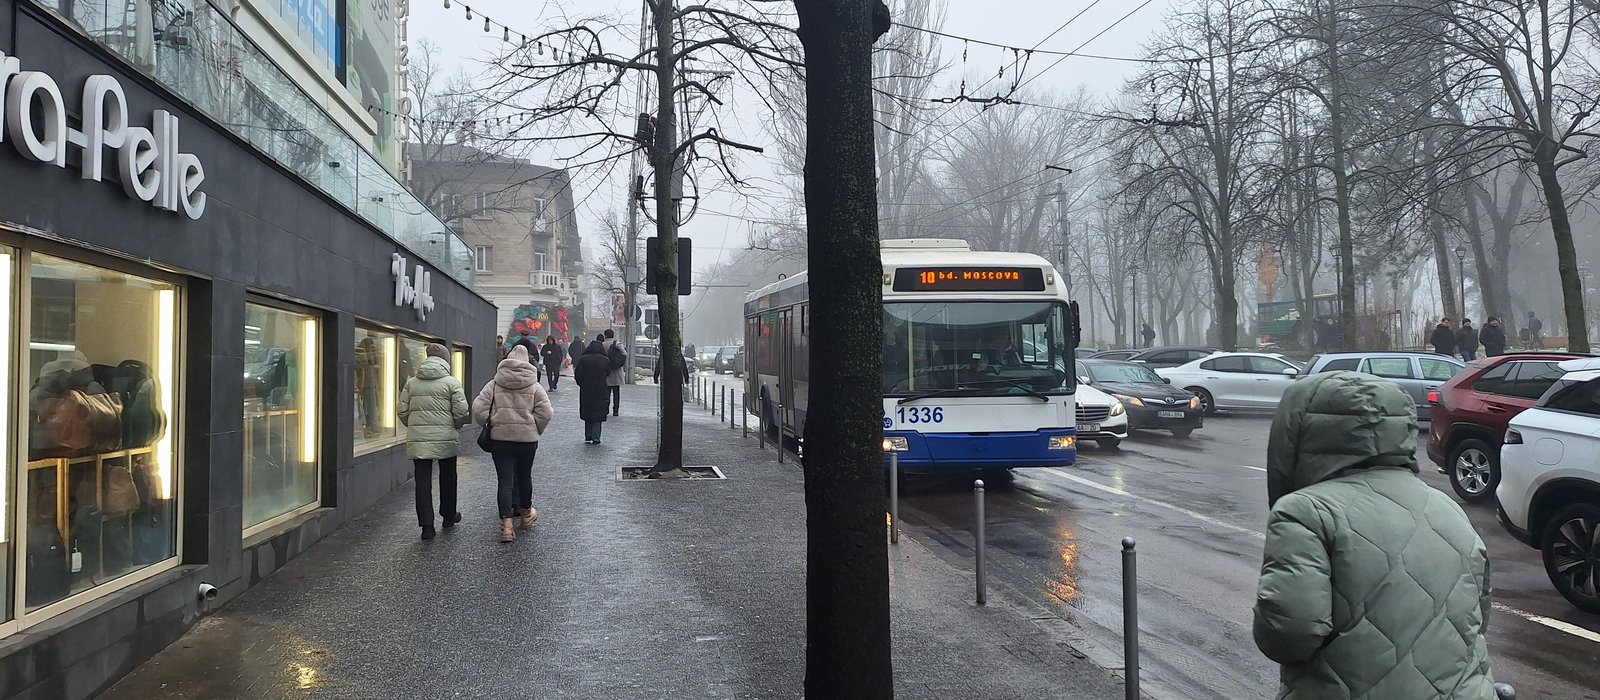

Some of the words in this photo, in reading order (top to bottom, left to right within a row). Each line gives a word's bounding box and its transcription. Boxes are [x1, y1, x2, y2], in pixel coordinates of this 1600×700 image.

[920, 271, 936, 284] 10
[938, 271, 958, 280] bd.
[963, 271, 1019, 280] MOSCOVA
[897, 406, 944, 424] 1336
